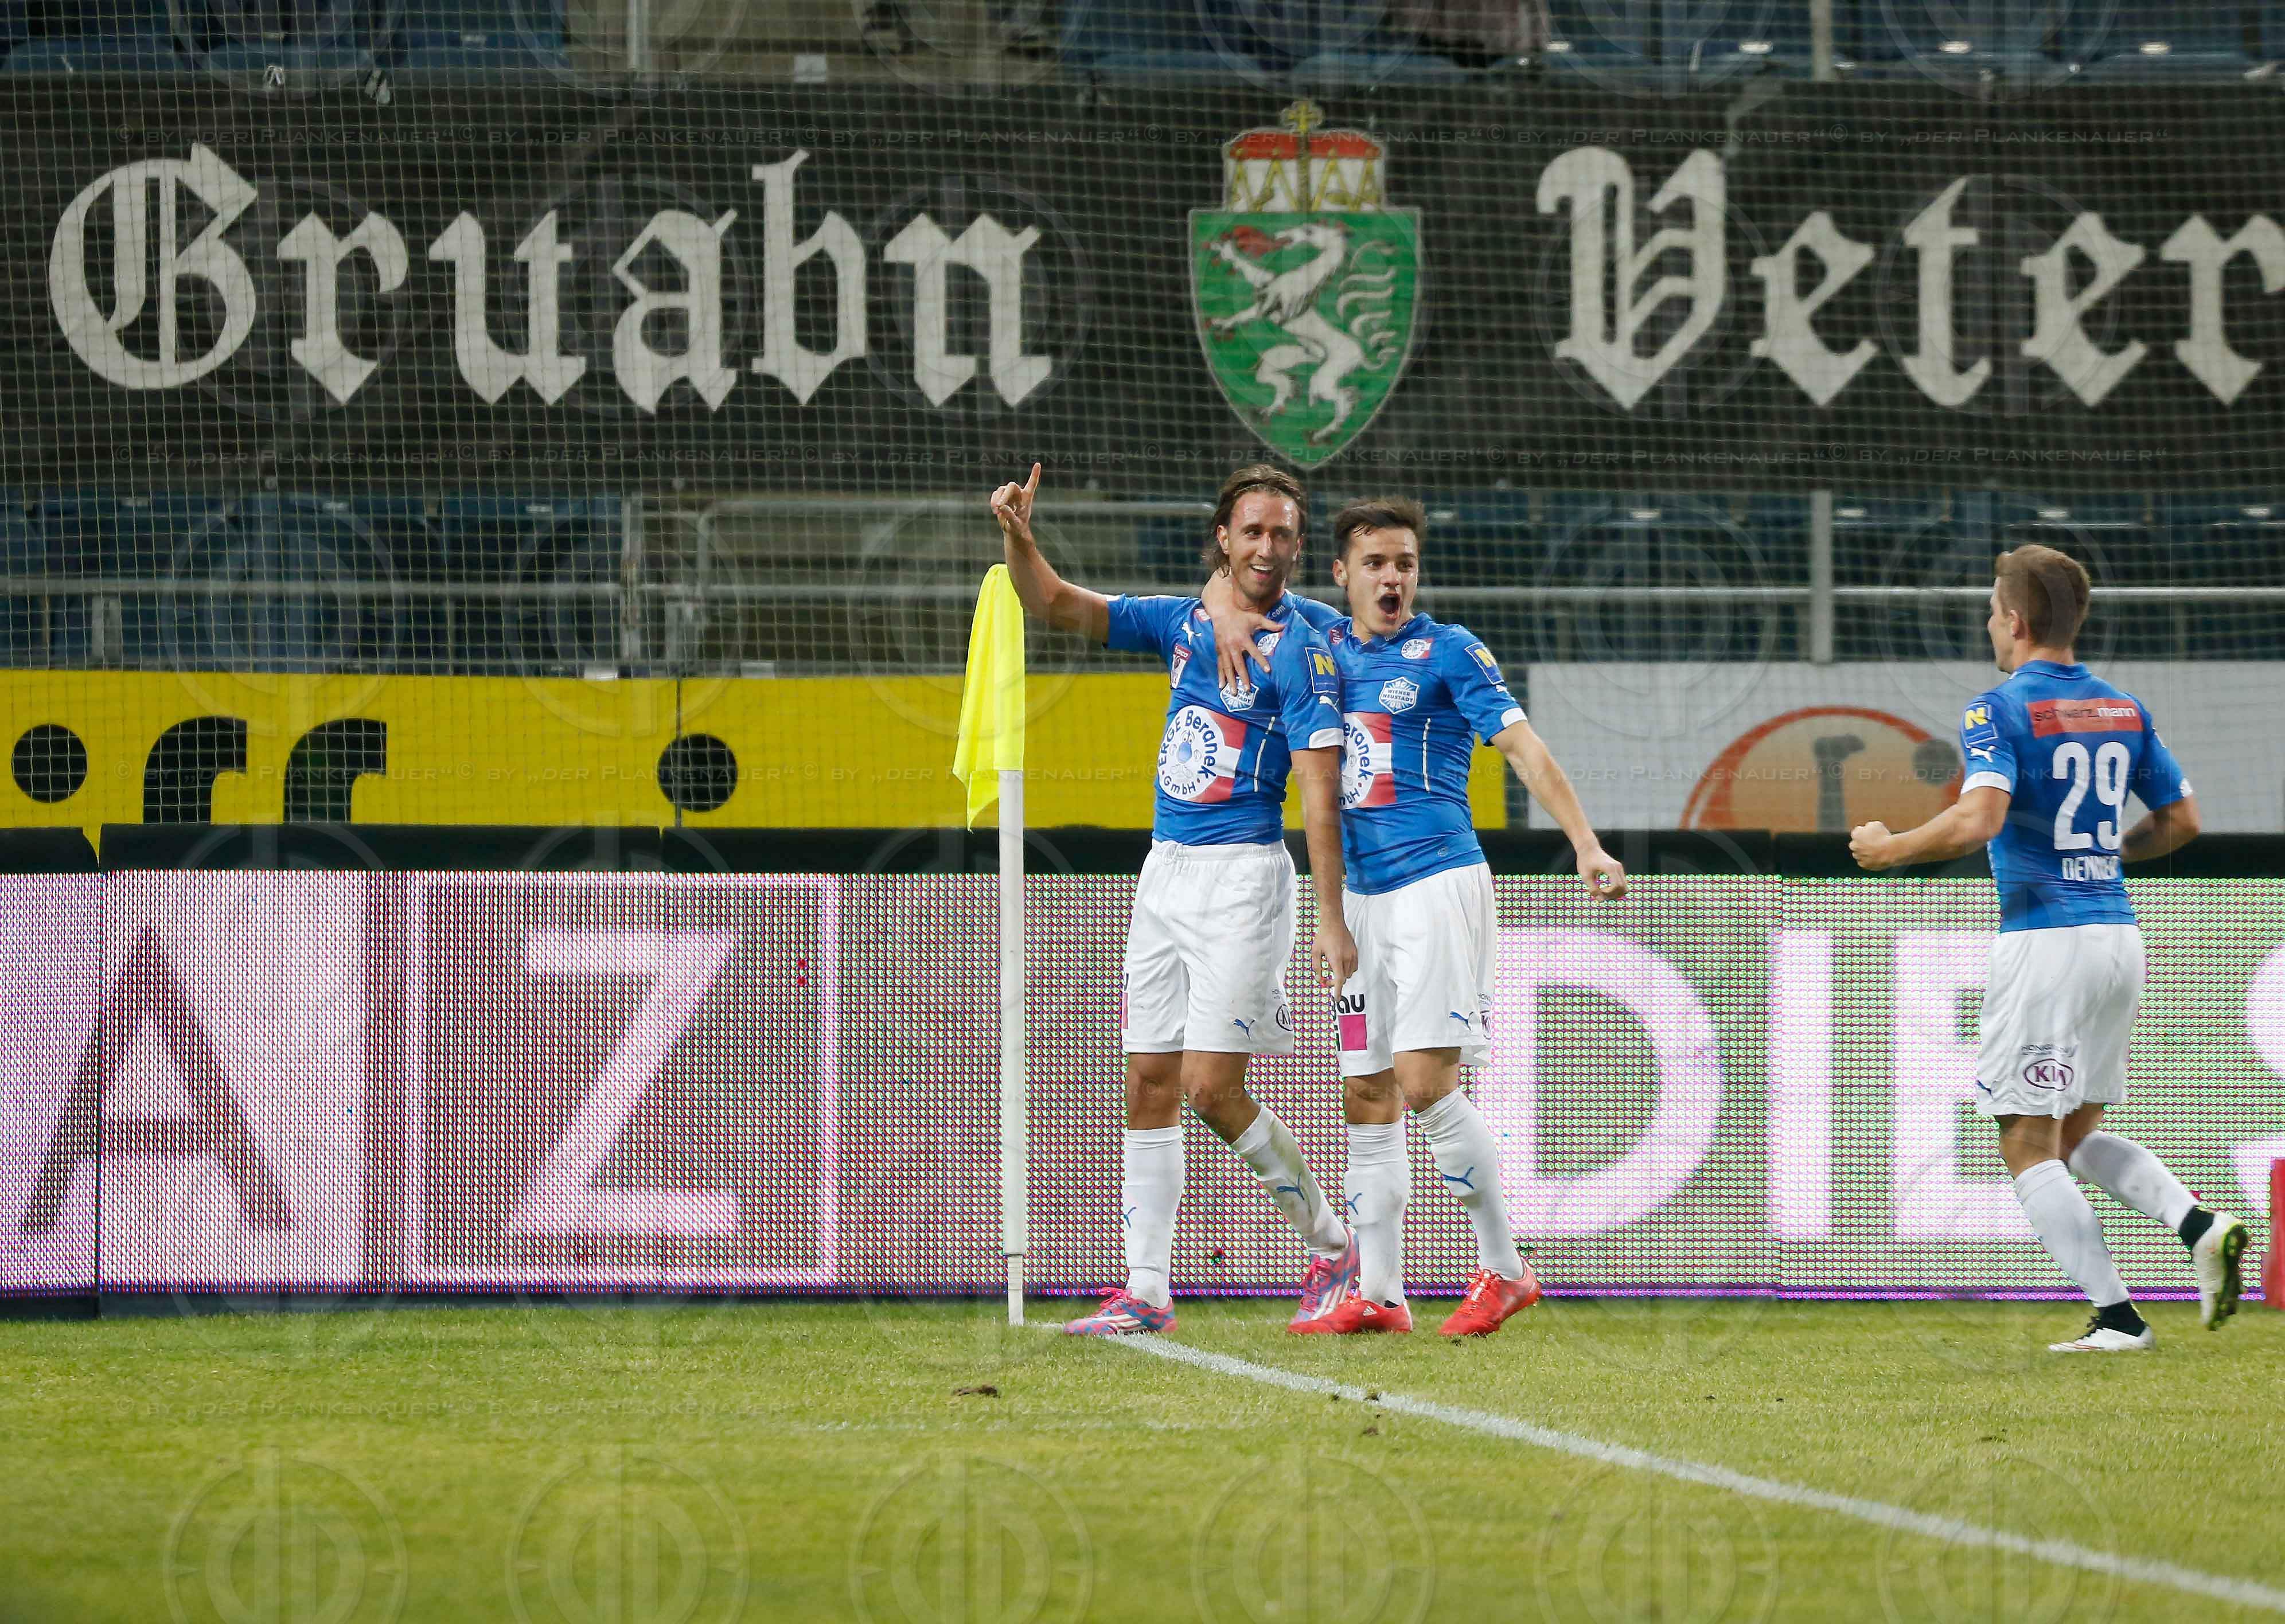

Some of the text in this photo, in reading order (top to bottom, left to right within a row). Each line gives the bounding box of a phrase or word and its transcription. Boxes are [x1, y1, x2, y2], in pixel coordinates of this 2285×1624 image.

[49, 143, 2285, 415] Gruabn Veter
[1312, 653, 1336, 676] N
[1383, 693, 1414, 702] NEUSTADT
[1964, 707, 1988, 729] N
[1158, 709, 1218, 779] ERGE Beranek
[1343, 723, 1374, 781] eranek
[1163, 775, 1196, 795] GmbH
[2052, 740, 2130, 851] 29
[1475, 927, 2285, 1241] DIE
